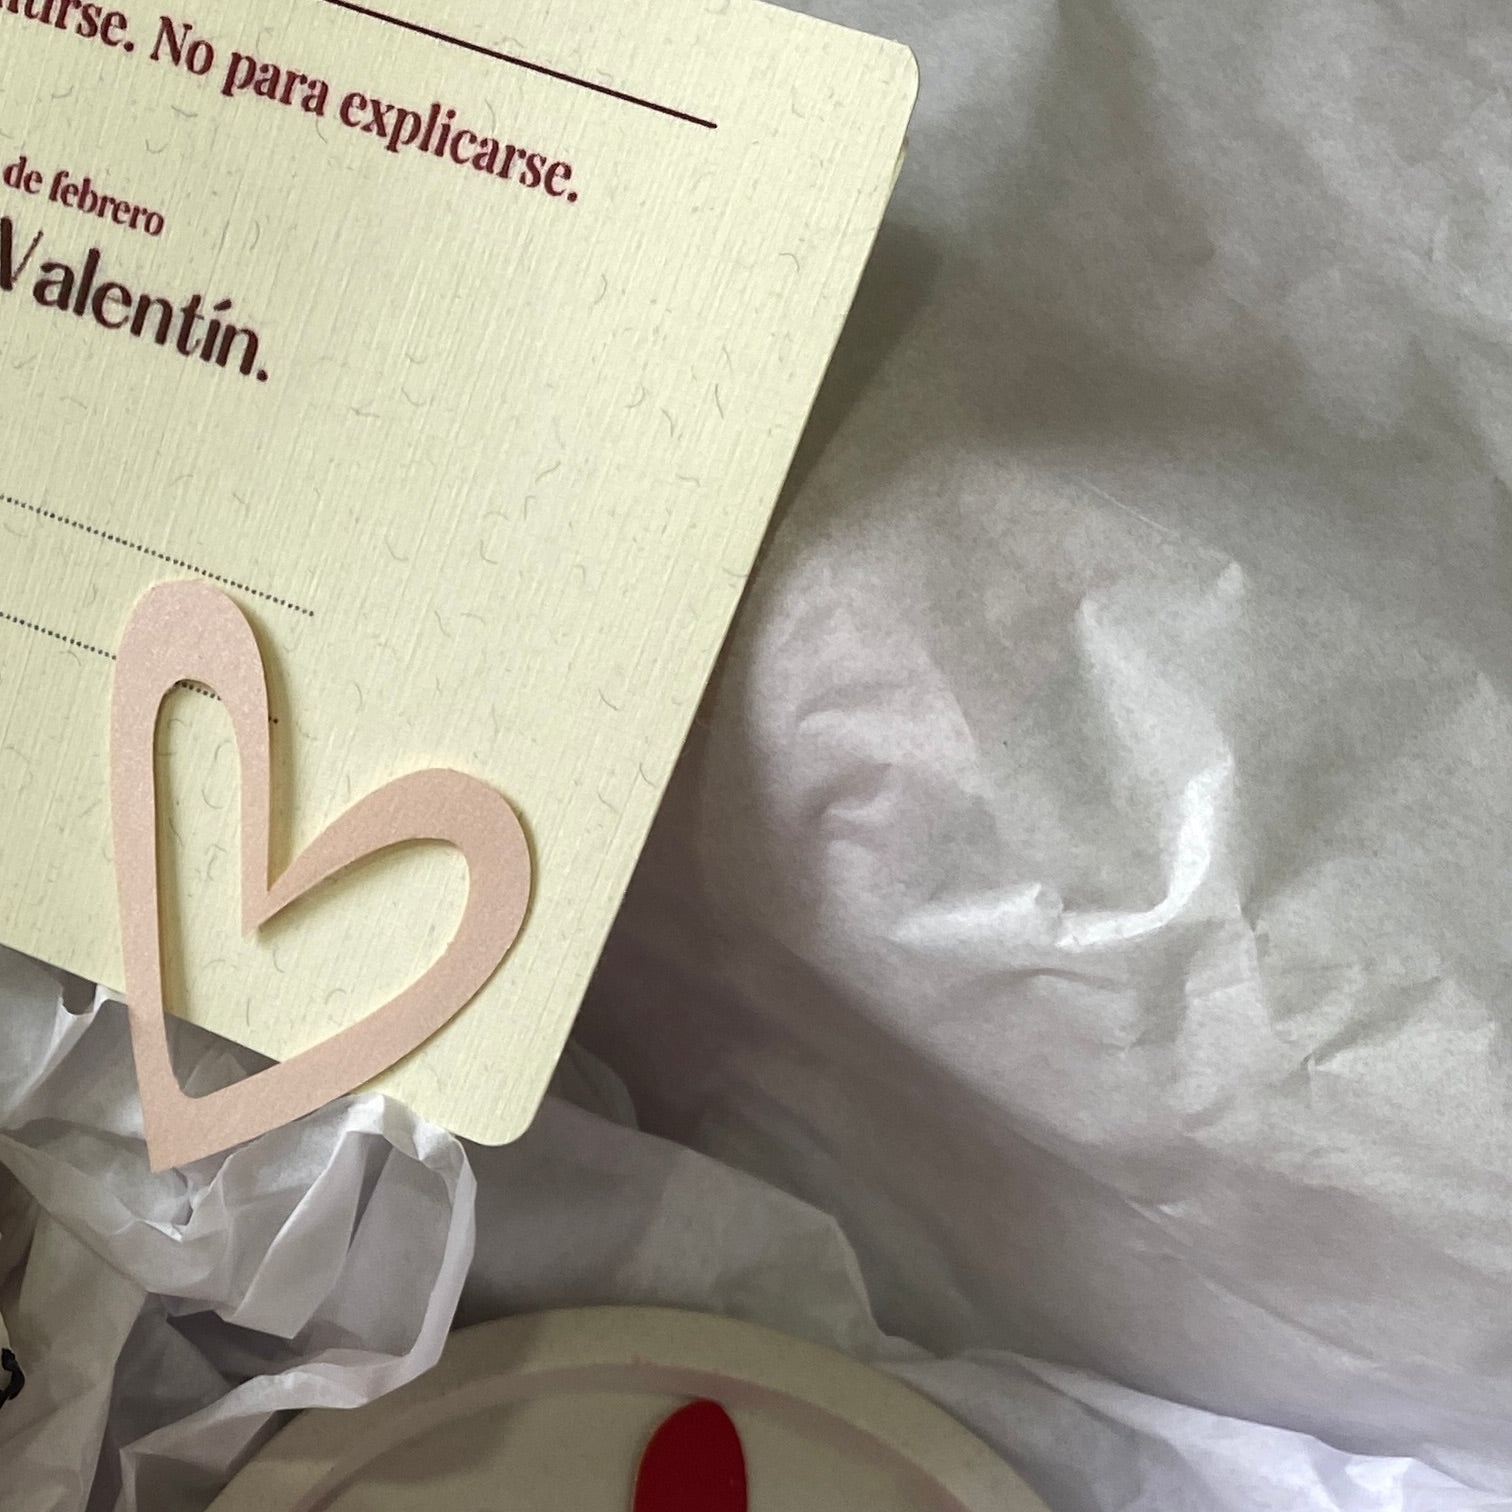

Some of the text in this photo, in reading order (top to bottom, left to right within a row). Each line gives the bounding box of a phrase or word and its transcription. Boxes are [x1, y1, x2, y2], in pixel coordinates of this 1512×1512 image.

[149, 15, 215, 76] No
[220, 51, 330, 118] para
[338, 91, 580, 204] explicarse.
[2, 154, 44, 195] de
[47, 169, 166, 237] febrero
